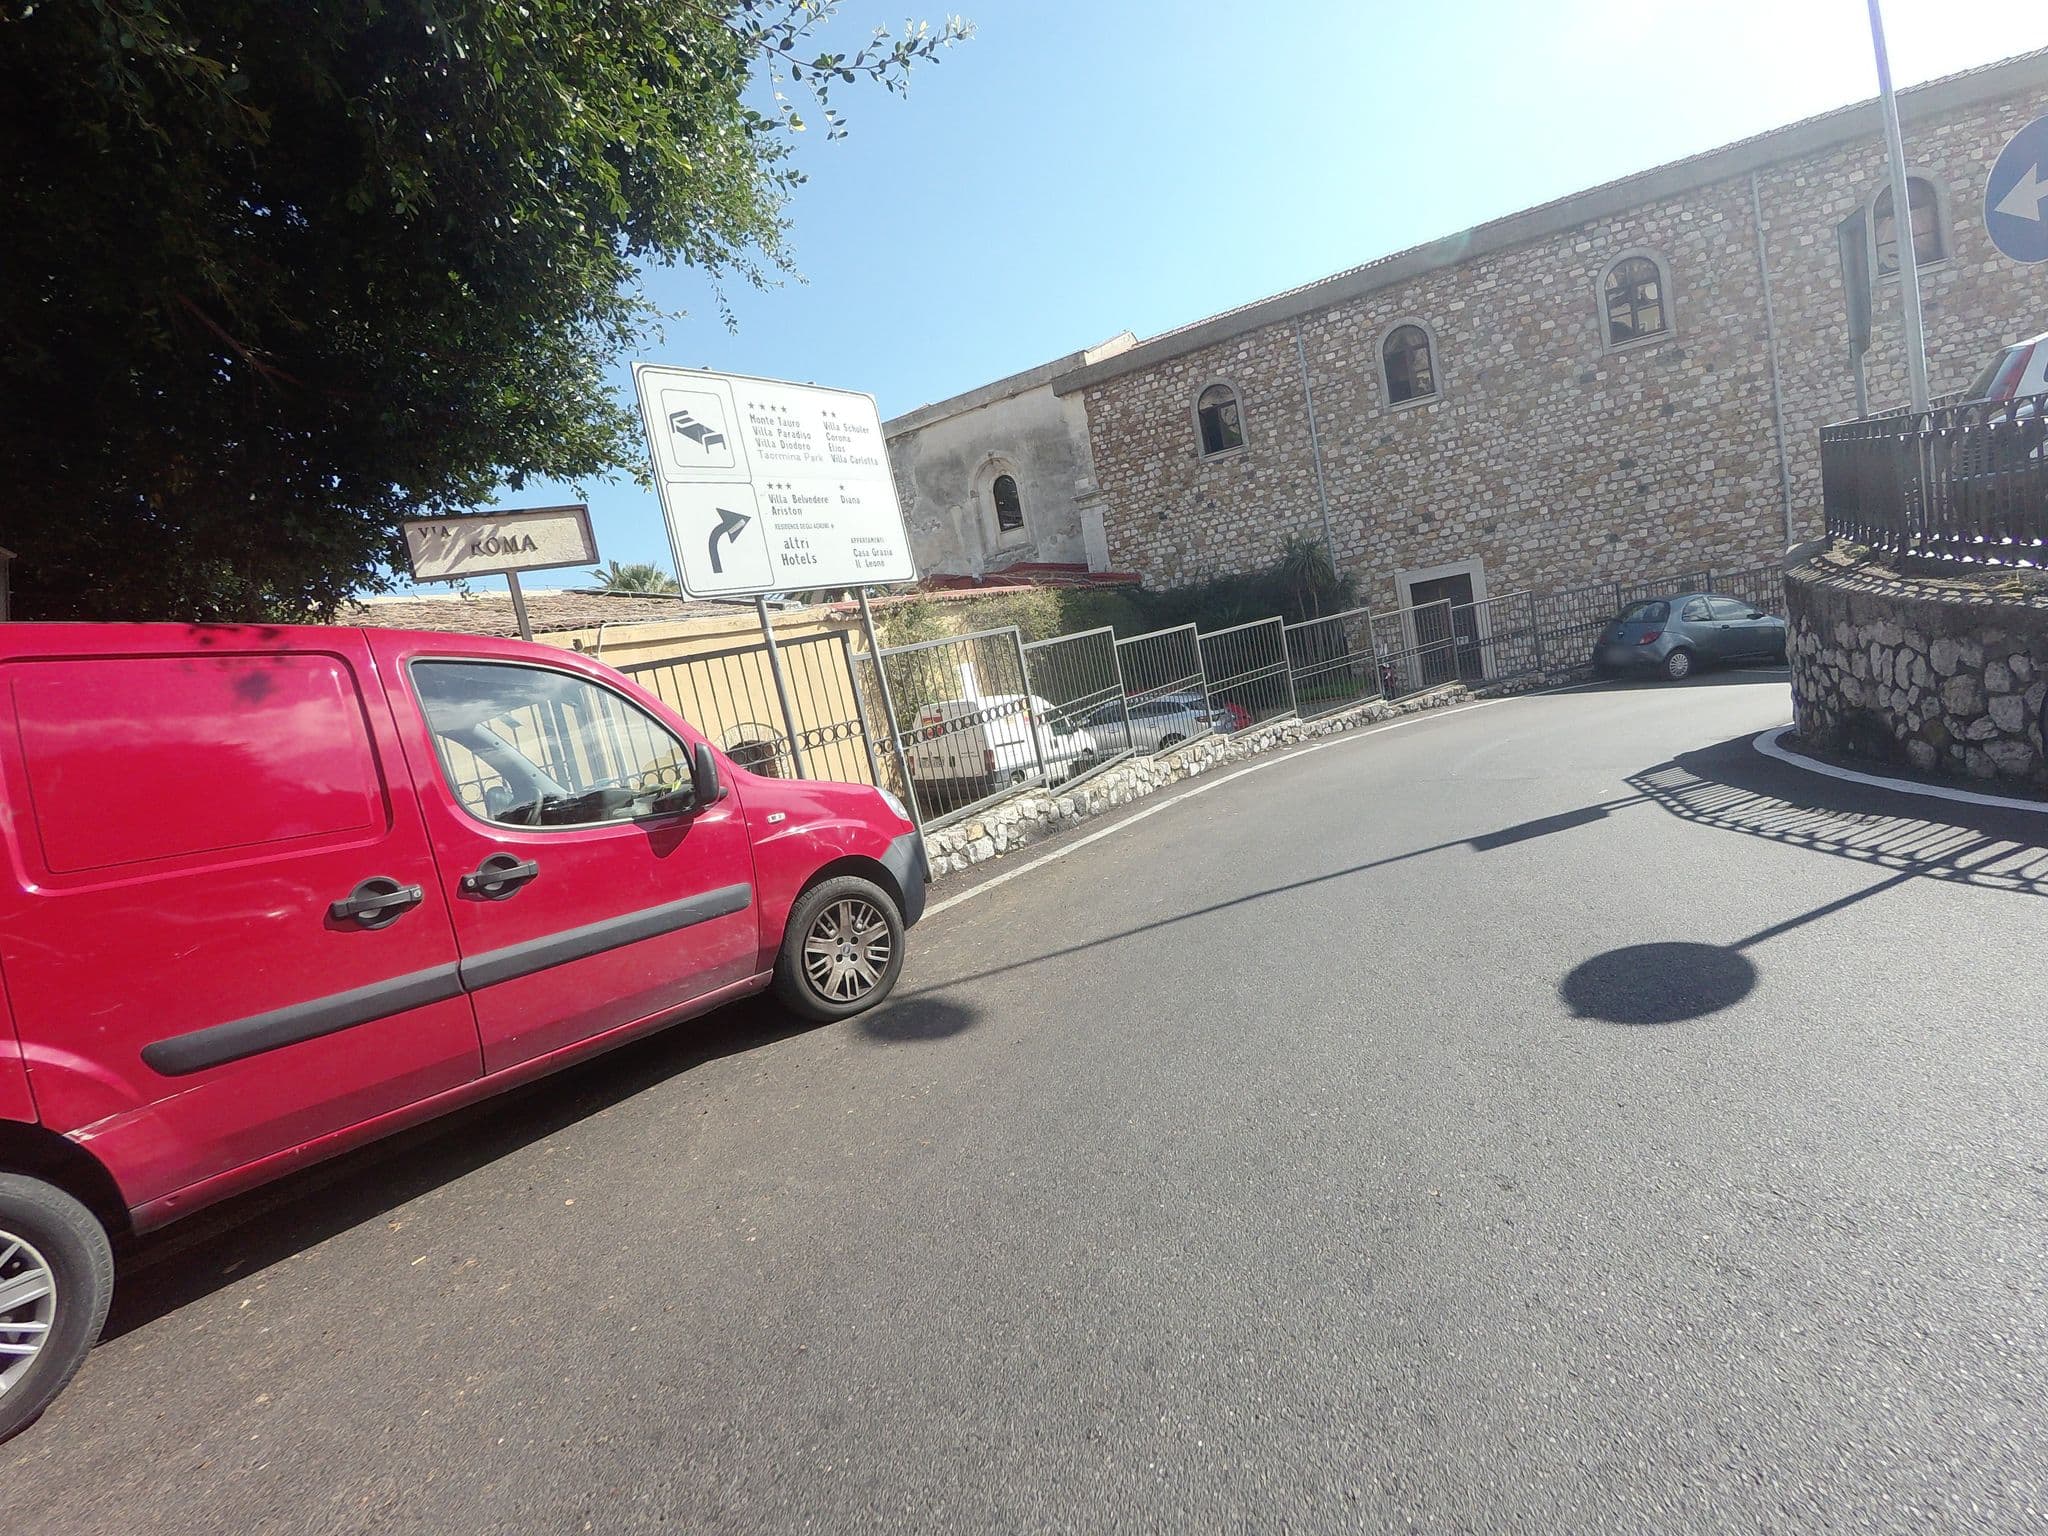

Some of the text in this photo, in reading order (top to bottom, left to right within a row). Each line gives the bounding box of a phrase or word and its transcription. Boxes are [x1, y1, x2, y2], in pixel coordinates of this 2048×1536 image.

[778, 416, 801, 428] Tauro
[823, 421, 841, 431] Villa
[752, 425, 811, 440] Villa Paradiso
[755, 437, 776, 449] Villa
[768, 493, 788, 504] Villa
[772, 505, 802, 516] Ariston
[418, 525, 451, 539] VIA
[784, 537, 810, 549] altri
[781, 552, 818, 566] Hotels
